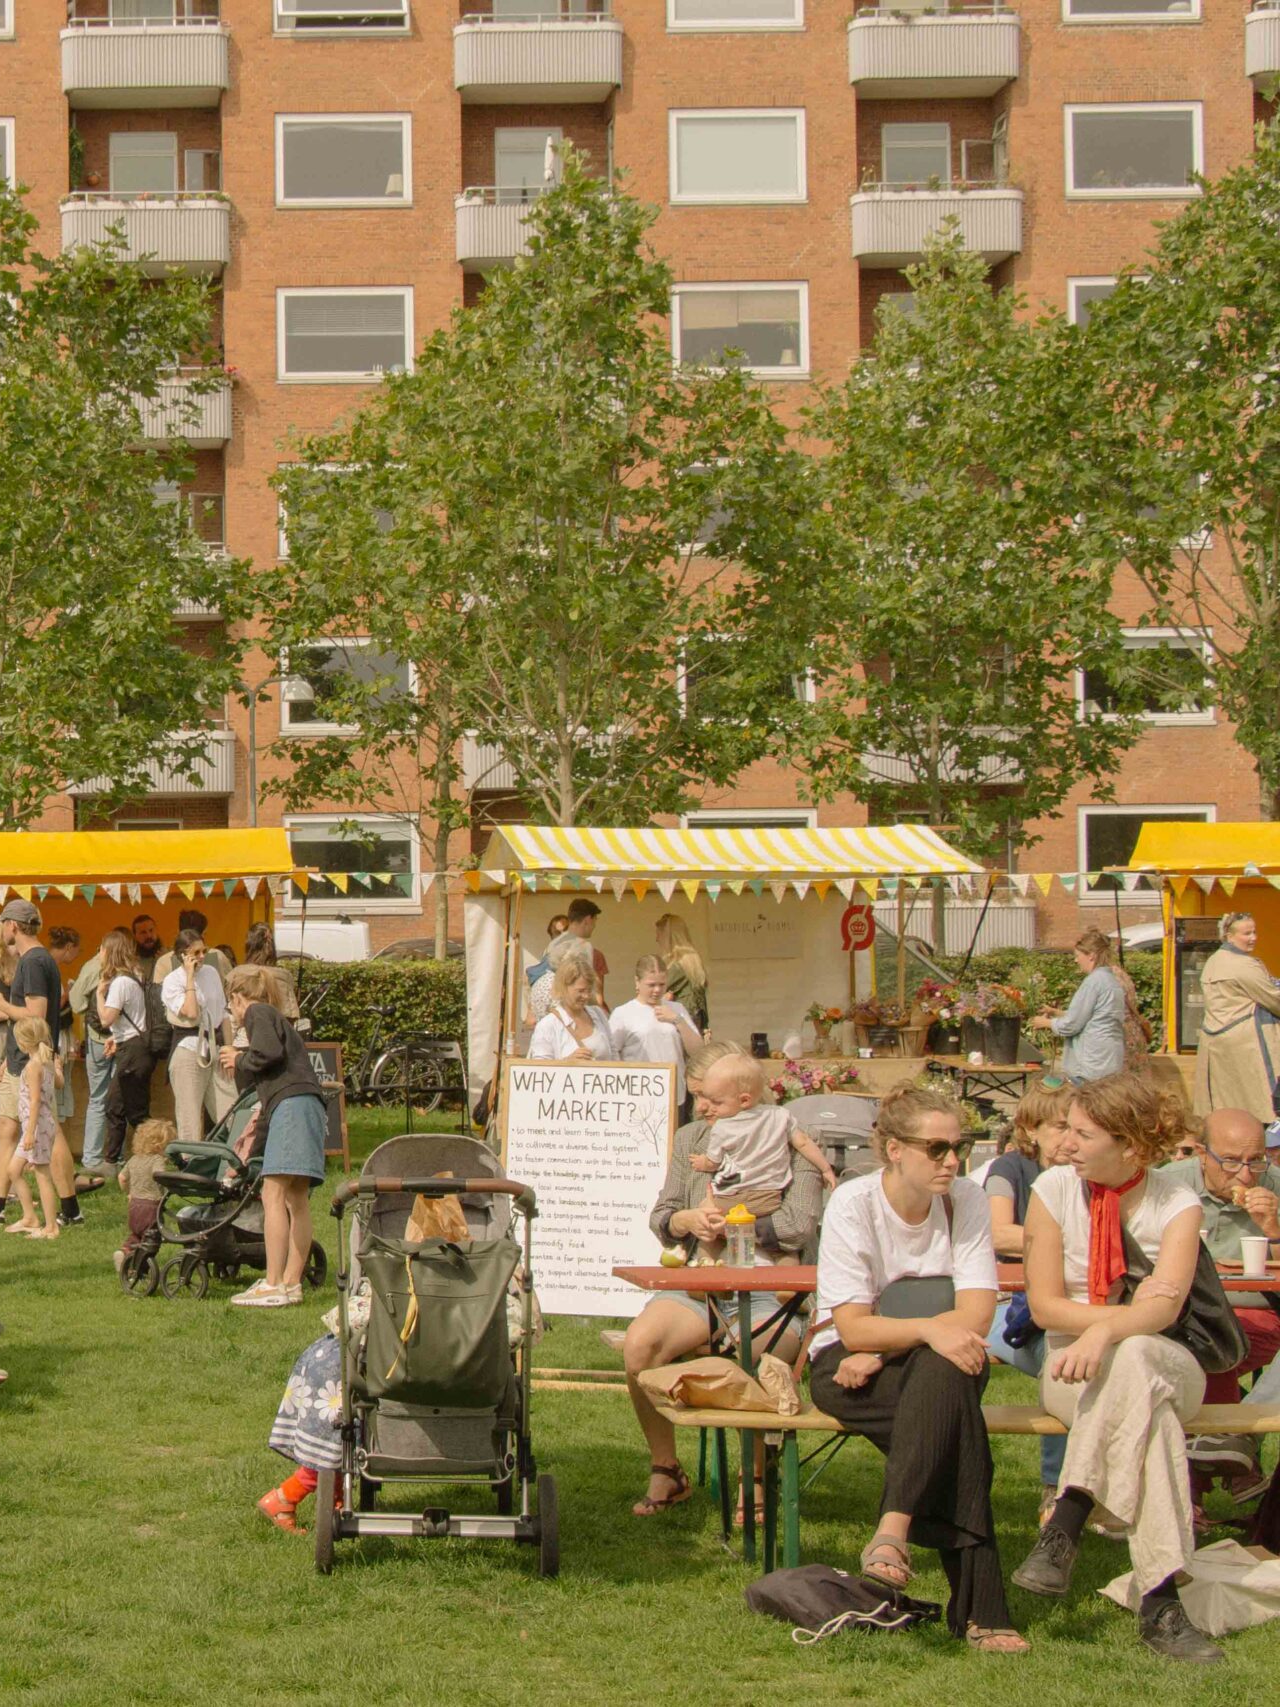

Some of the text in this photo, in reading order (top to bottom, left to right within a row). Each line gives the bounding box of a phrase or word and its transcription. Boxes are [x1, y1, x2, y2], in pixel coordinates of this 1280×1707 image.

[513, 1071, 666, 1097] WHY A FARMERS
[538, 1098, 638, 1123] MARKET?
[516, 1127, 631, 1138] to meet and learn from farmers
[515, 1141, 524, 1149] to
[525, 1140, 557, 1150] cultivate
[565, 1142, 589, 1151] diverse
[591, 1142, 608, 1152] food
[612, 1144, 639, 1155] system
[524, 1154, 544, 1163] foster
[546, 1155, 582, 1165] connection
[584, 1157, 600, 1166] with
[601, 1157, 612, 1166] the
[615, 1157, 631, 1167] food
[647, 1160, 661, 1168] eat
[623, 1173, 631, 1181] to
[538, 1181, 552, 1191] local
[546, 1198, 556, 1206] the
[558, 1198, 588, 1208] landscape
[553, 1212, 591, 1223] transparent
[593, 1213, 609, 1222] food
[540, 1225, 582, 1235] communities
[587, 1226, 609, 1236] around
[614, 1227, 630, 1237] food
[568, 1240, 586, 1249] food
[598, 1255, 607, 1264] for
[548, 1269, 573, 1278] support
[574, 1269, 609, 1279] alternative
[583, 1284, 611, 1296] exchange
[613, 1284, 624, 1293] and
